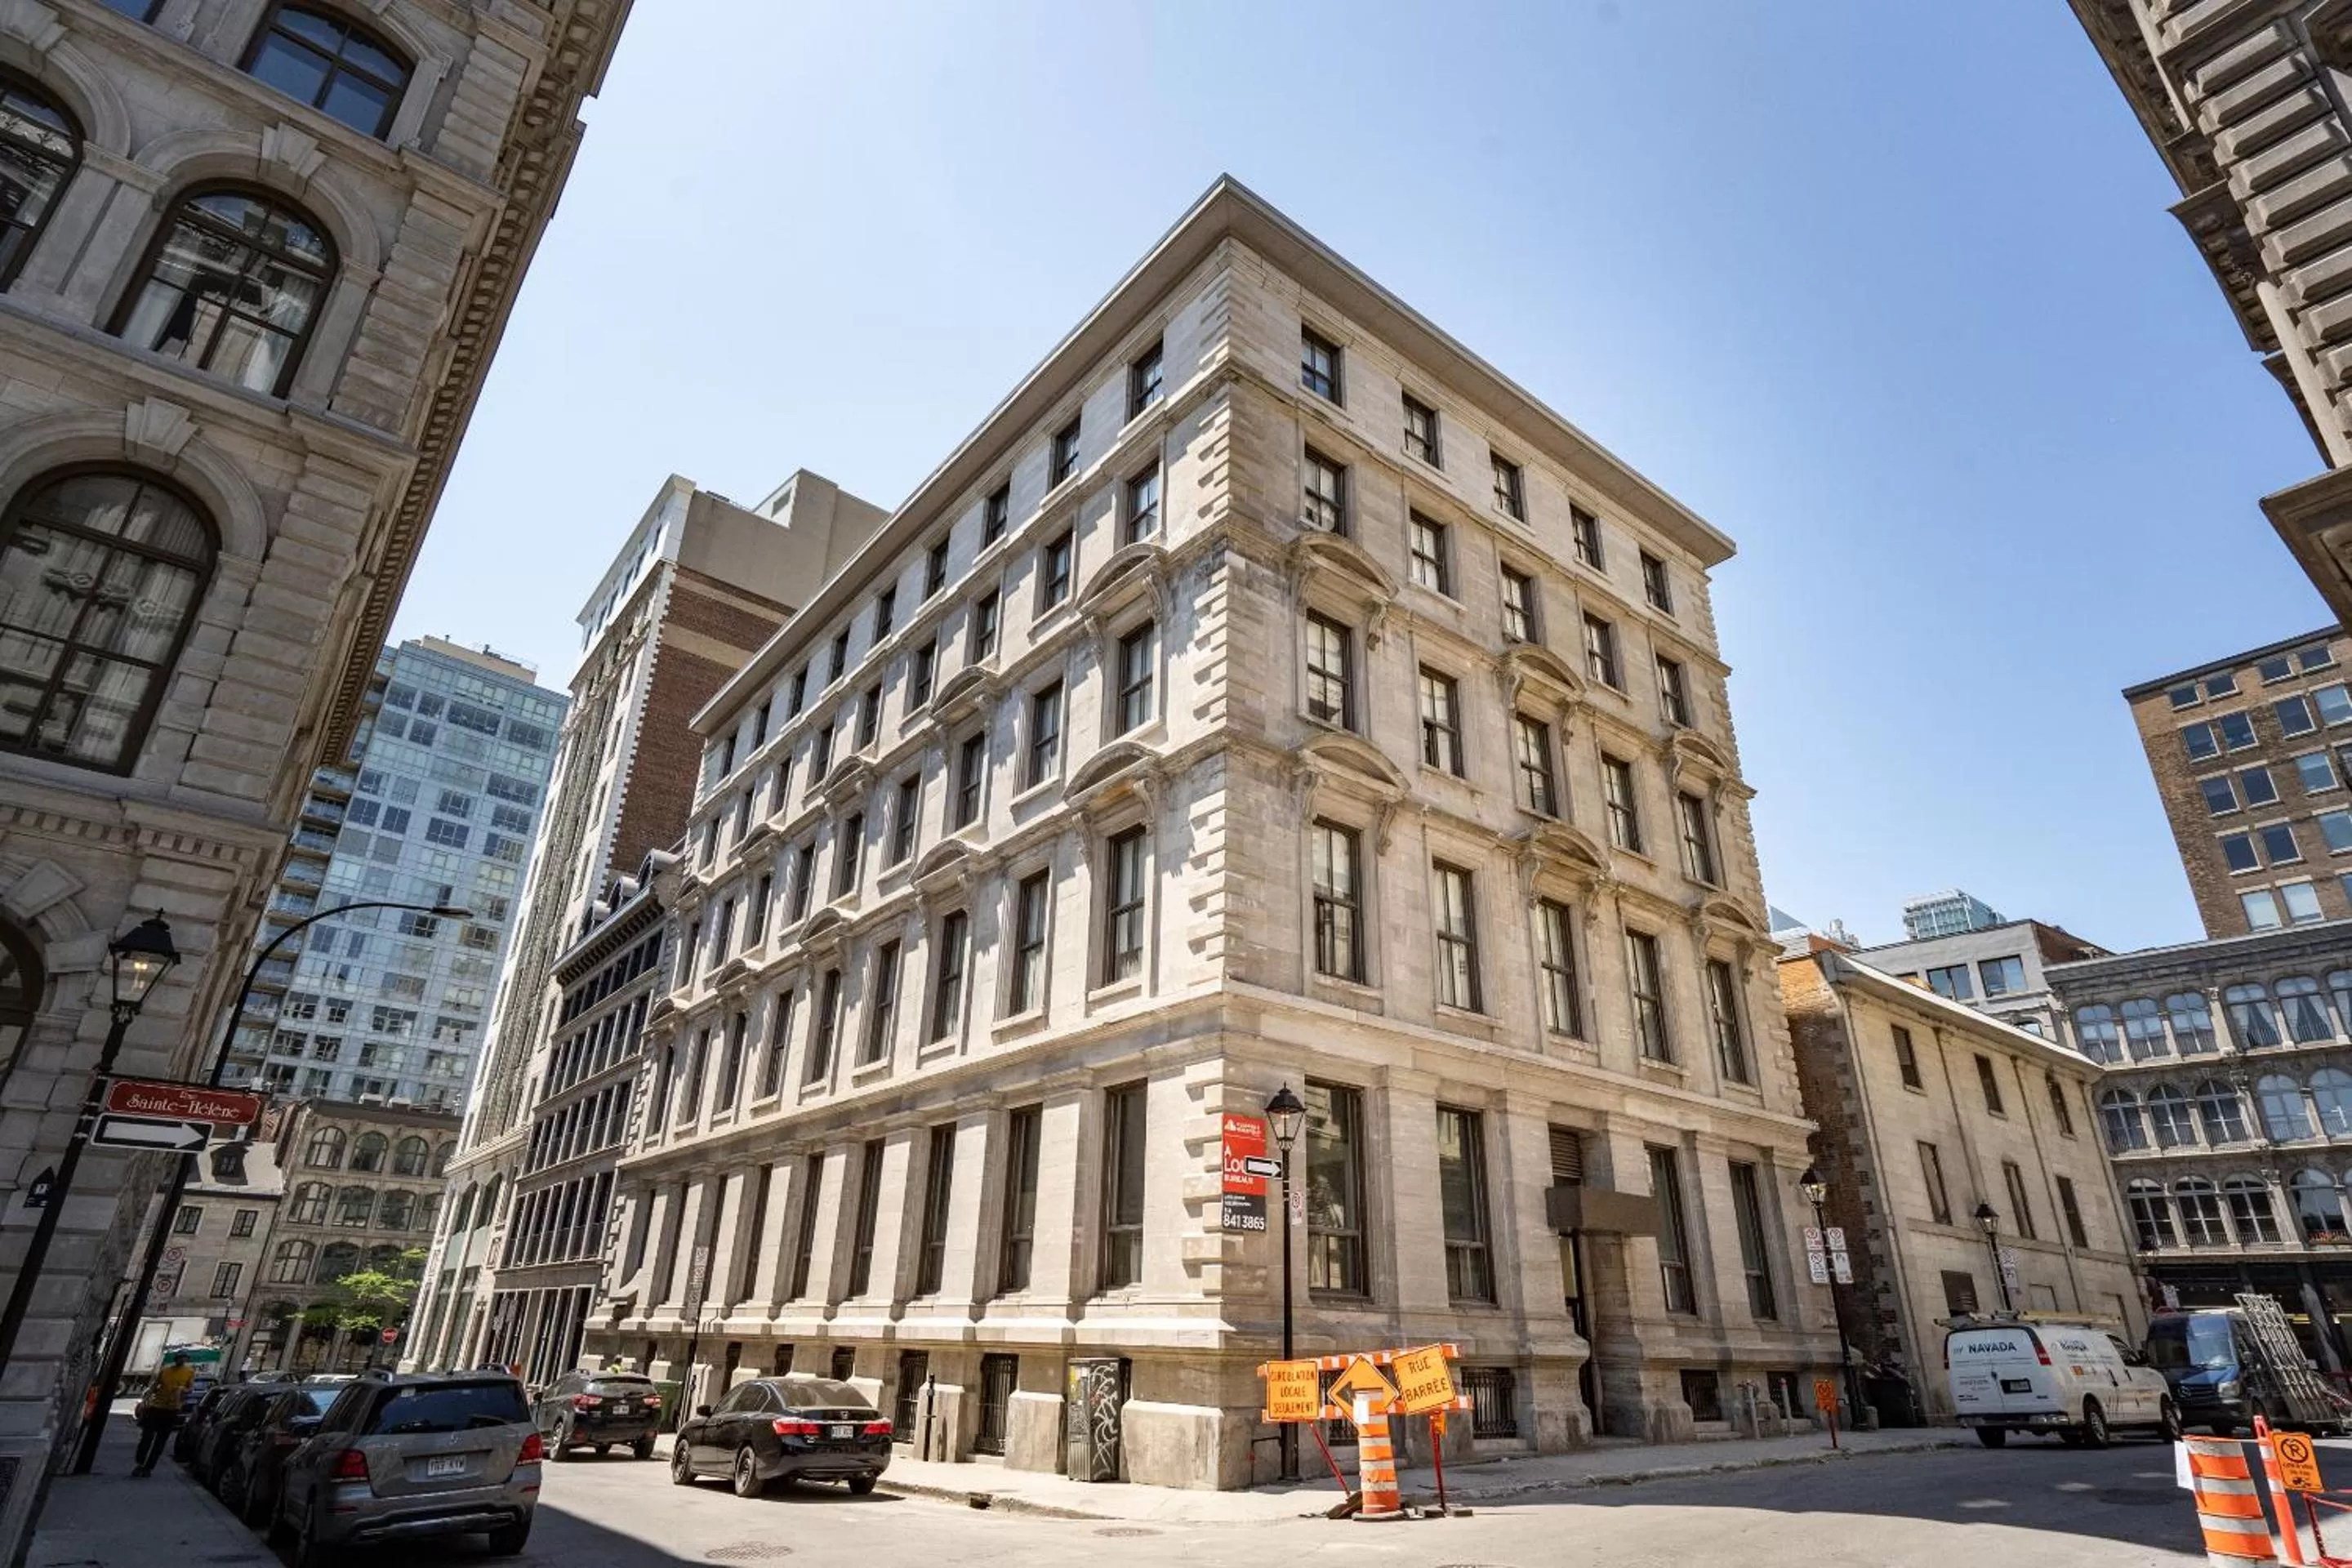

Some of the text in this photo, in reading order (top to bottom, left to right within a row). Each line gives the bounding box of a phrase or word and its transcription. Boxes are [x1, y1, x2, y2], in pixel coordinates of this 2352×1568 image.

[1968, 1342, 2017, 1354] NAVADA
[1408, 1356, 1431, 1374] RUE
[1281, 1386, 1307, 1398] LOCALE
[1273, 1401, 1314, 1414] SEULEMENT
